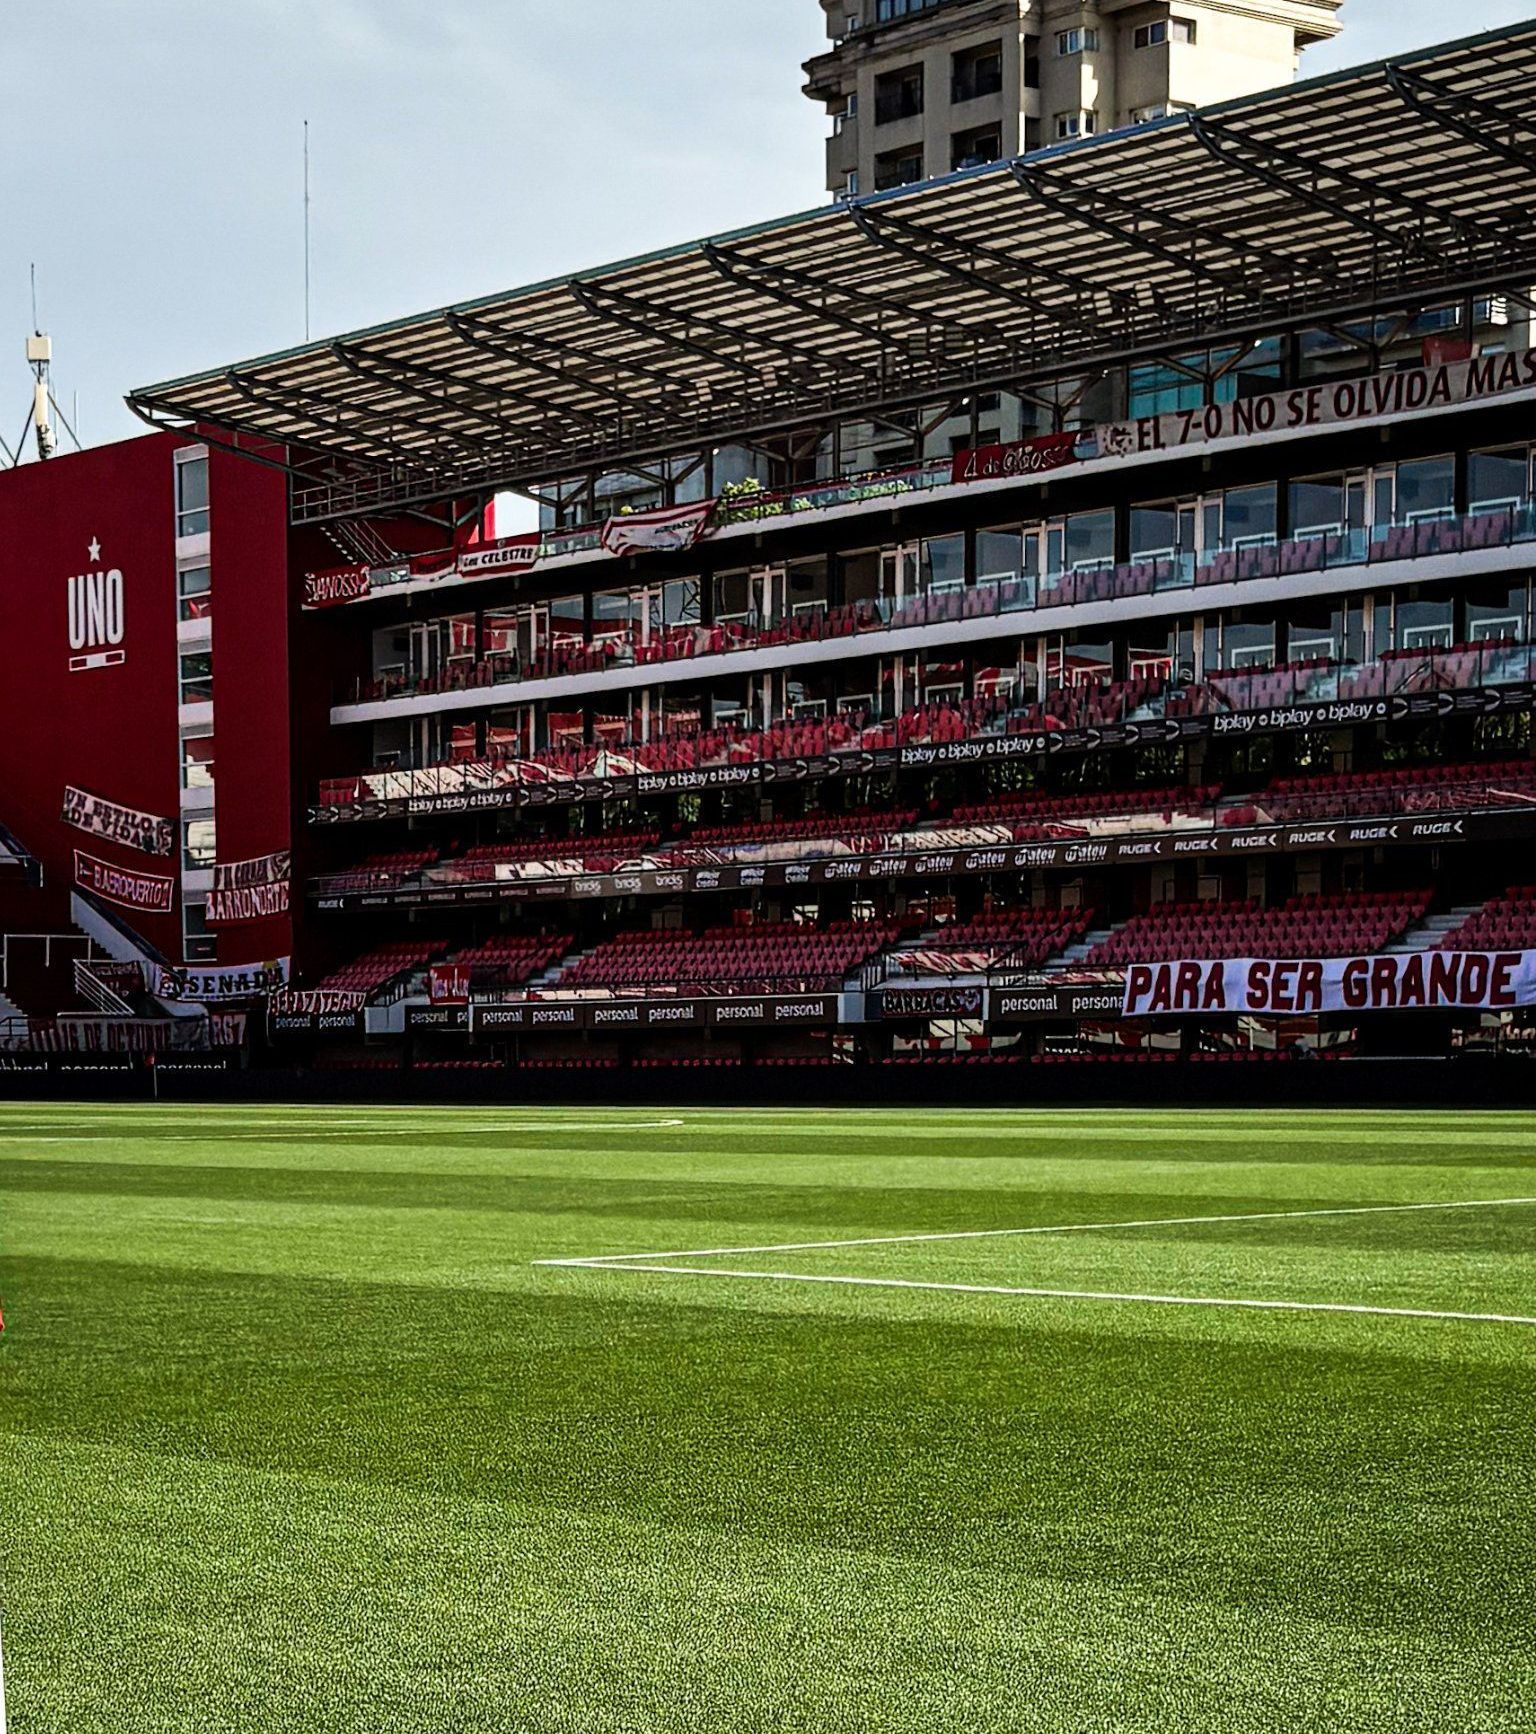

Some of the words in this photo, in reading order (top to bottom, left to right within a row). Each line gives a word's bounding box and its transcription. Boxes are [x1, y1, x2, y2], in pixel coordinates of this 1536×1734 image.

[1138, 418, 1167, 451] EL
[1177, 403, 1222, 444] 7-0
[1233, 399, 1276, 436] NO
[1287, 388, 1322, 427] SE
[1333, 366, 1452, 419] OLVIDA
[1466, 347, 1536, 398] MAS
[67, 568, 124, 650] UNO
[1126, 962, 1226, 1014] PARA
[1246, 961, 1324, 1011] SER
[1342, 952, 1522, 1008] GRANDE
[717, 1003, 763, 1022] personal
[774, 1001, 824, 1020] personal
[1001, 994, 1058, 1014] personal
[1072, 995, 1123, 1014] persona
[411, 1010, 448, 1025] personal
[483, 1009, 523, 1026] personal
[532, 1007, 575, 1025] personal
[595, 1006, 639, 1025] personal
[649, 1005, 694, 1024] personal
